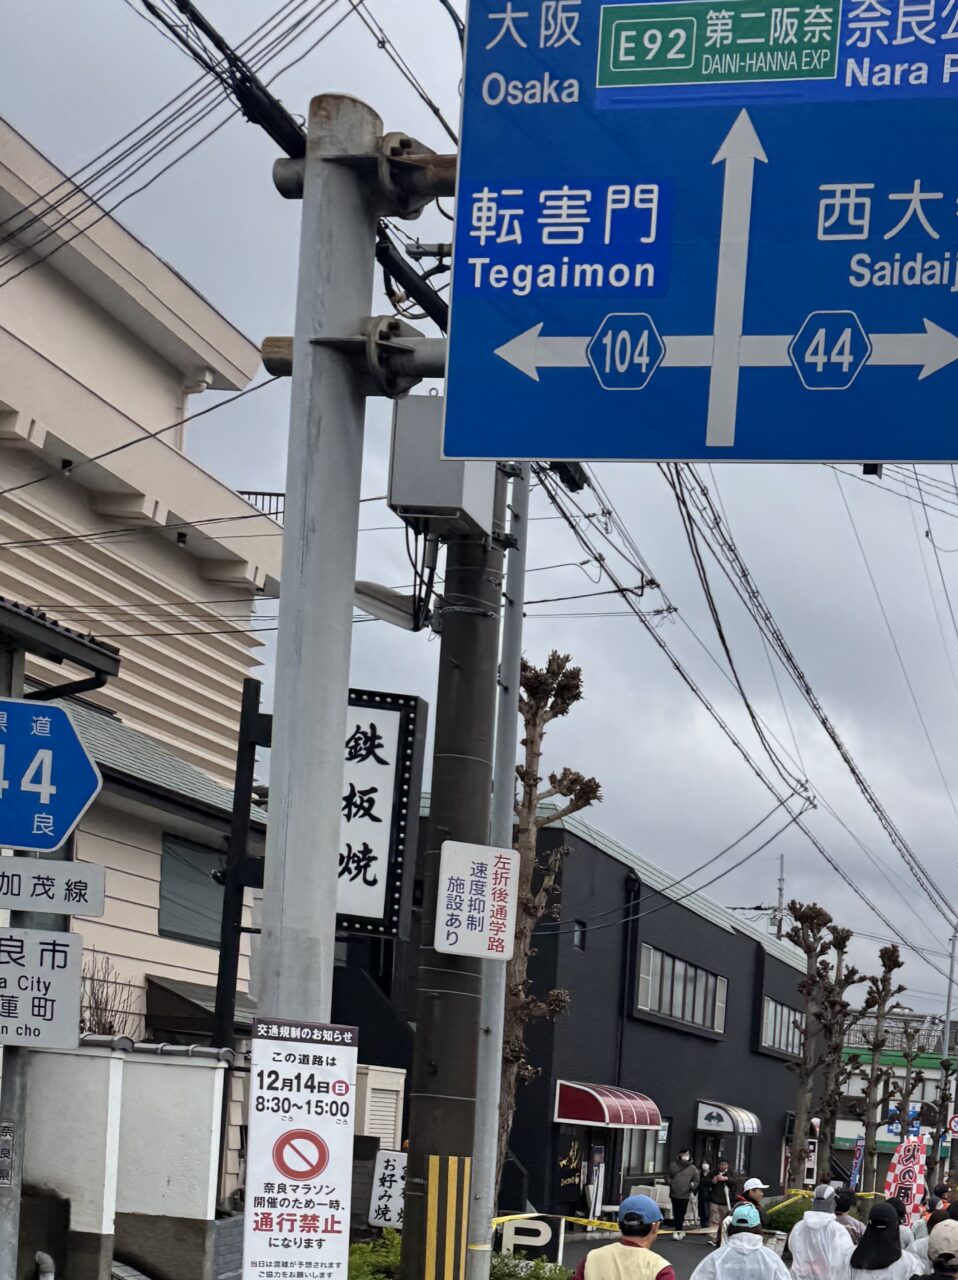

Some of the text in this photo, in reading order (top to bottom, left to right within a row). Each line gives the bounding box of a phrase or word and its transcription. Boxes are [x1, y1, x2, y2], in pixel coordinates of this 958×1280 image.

[486, 0, 583, 49] 大阪
[704, 5, 834, 48] 第二阪奈
[618, 28, 687, 61] E92
[702, 49, 831, 76] DAINI-HANNA EXP
[845, 58, 929, 87] Nara
[481, 72, 580, 106] Osaka
[470, 184, 661, 246] 転害門
[468, 257, 656, 297] Tegaimon
[601, 329, 651, 374] 104
[804, 328, 855, 373] 44
[0, 743, 57, 805] 4
[338, 722, 391, 887] 鉄板焼
[31, 812, 55, 837] 良
[0, 871, 89, 903] 加茂線
[466, 861, 489, 933] 速度抑制
[487, 854, 512, 953] 左折後通学路
[445, 876, 466, 946] 施設あり
[0, 935, 70, 970] 良市
[17, 975, 51, 995] City
[16, 1024, 41, 1037] cho
[257, 1024, 353, 1043] 交通規制のお知らせ
[272, 1052, 337, 1067] この道路は
[254, 1197, 345, 1211] 開催のため一時、
[264, 1183, 336, 1195] 奈良マラソン
[374, 1158, 398, 1222] お好み焼
[253, 1212, 343, 1234] 通行禁止
[502, 1219, 552, 1256] P
[268, 1237, 326, 1249] になります
